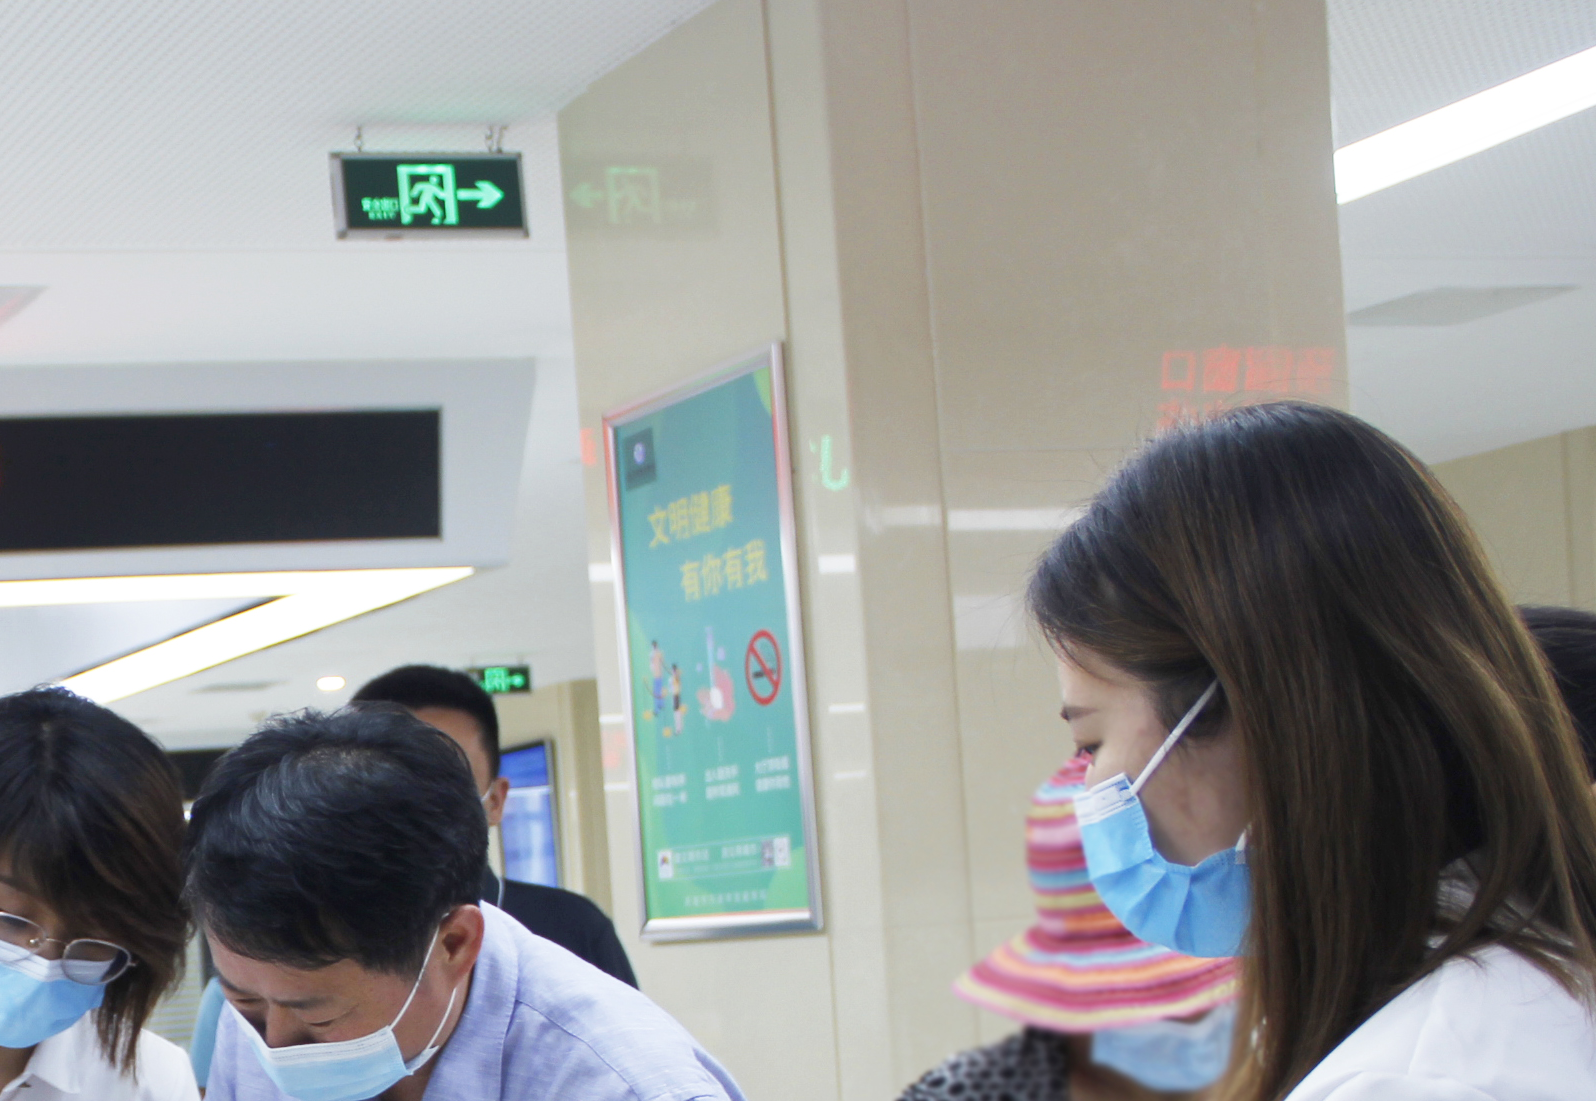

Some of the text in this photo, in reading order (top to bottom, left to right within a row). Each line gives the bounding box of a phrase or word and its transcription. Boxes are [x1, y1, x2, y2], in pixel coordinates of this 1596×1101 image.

[647, 483, 733, 548] 文明健康
[679, 538, 770, 602] 有你有我
